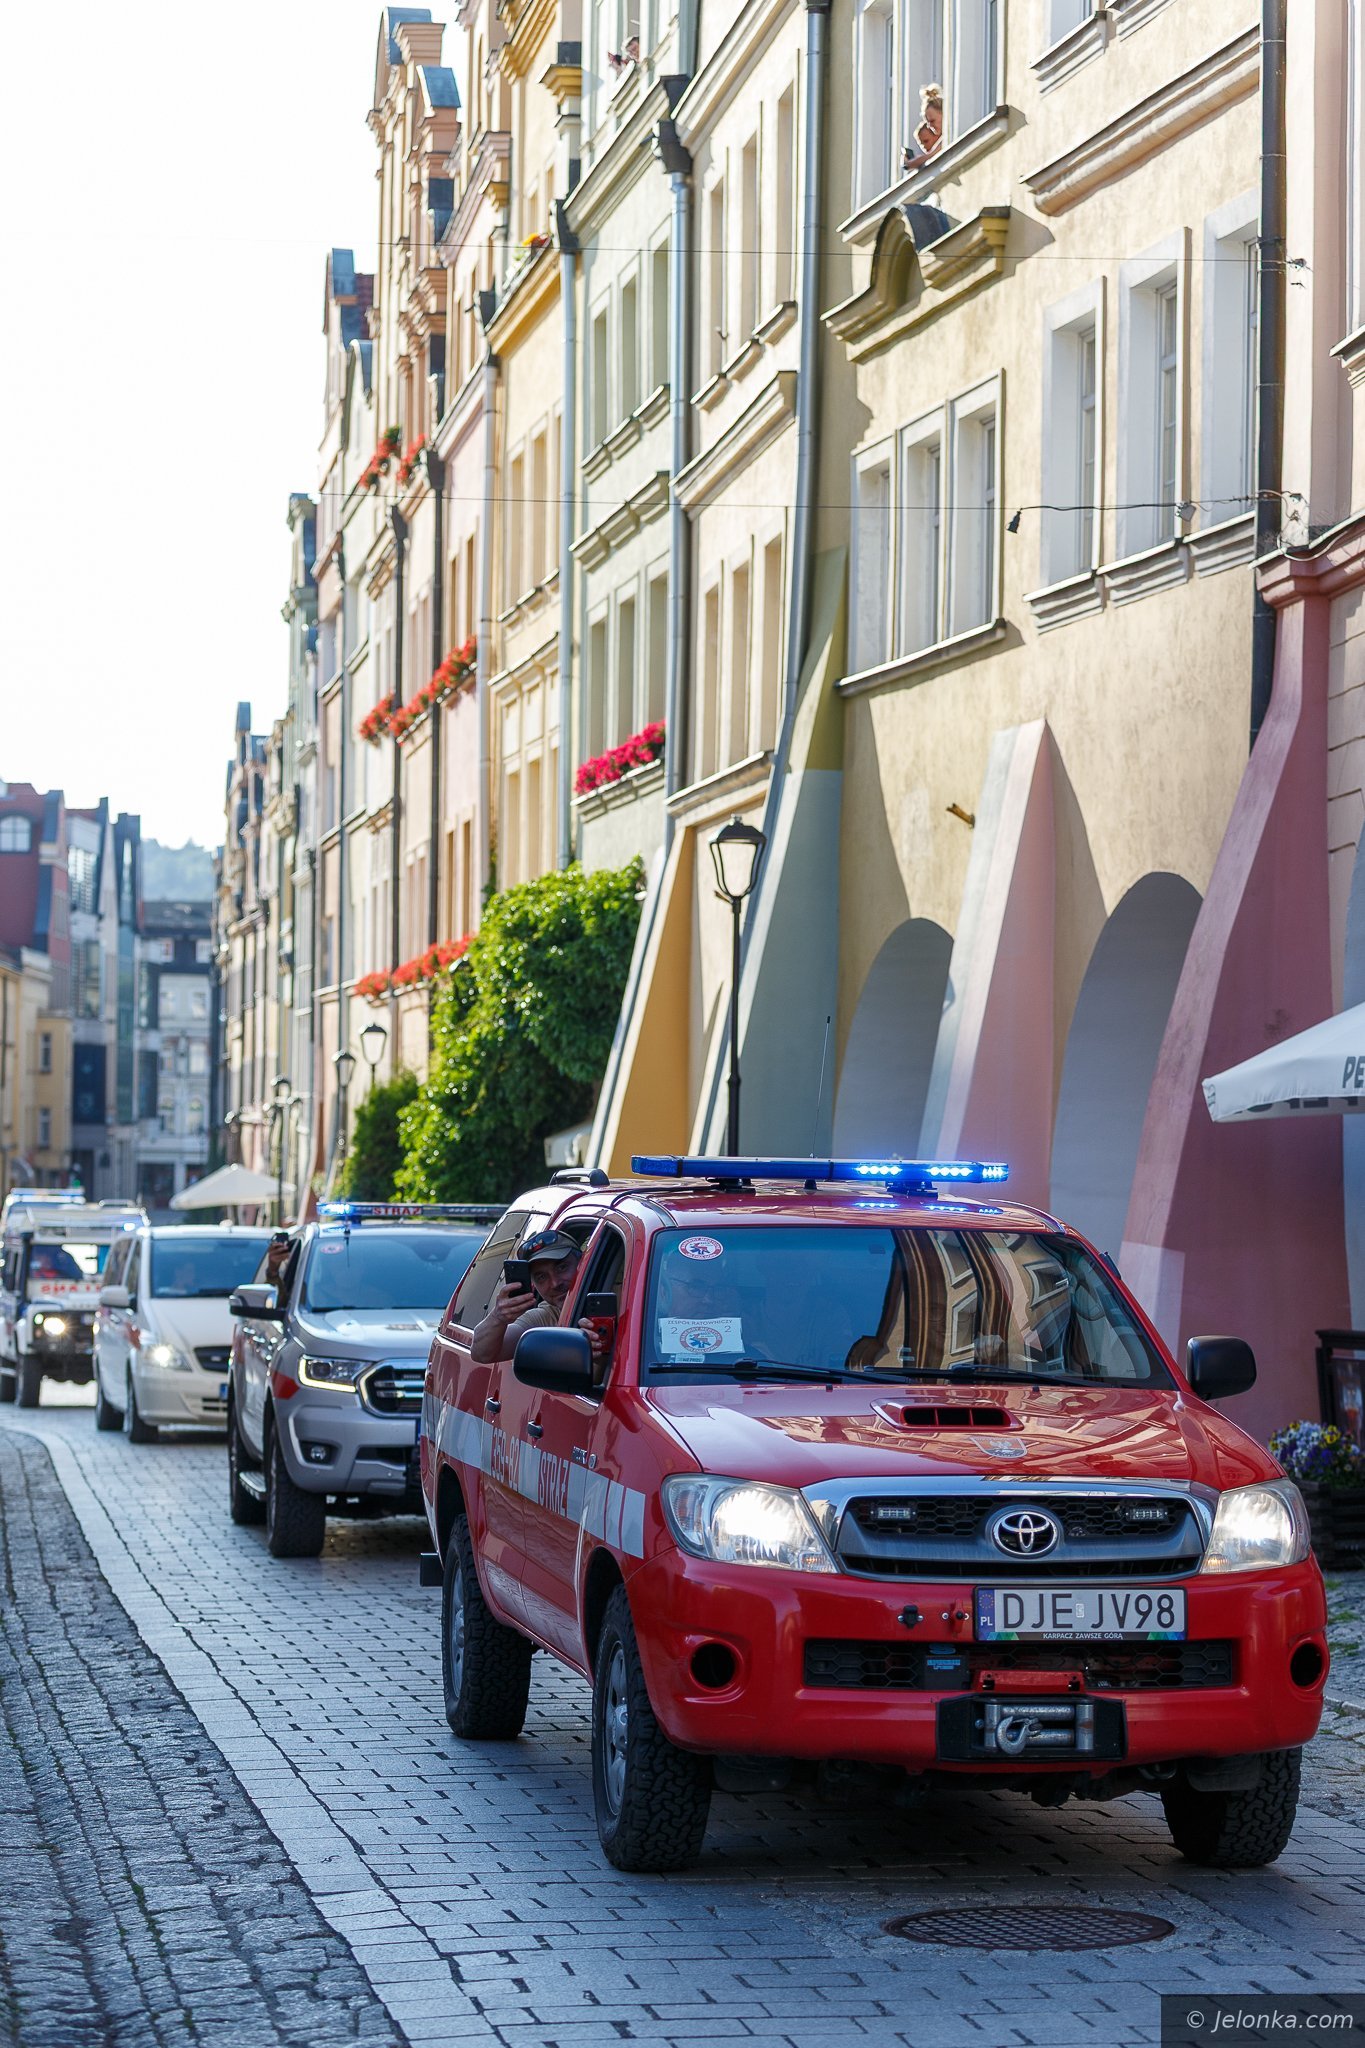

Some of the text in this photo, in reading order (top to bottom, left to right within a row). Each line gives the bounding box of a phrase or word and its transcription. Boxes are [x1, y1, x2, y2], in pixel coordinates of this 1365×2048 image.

[1003, 1593, 1175, 1629] DJE JV98
[980, 1616, 993, 1626] PL
[1043, 1632, 1073, 1640] KARPACZ
[1075, 1632, 1102, 1640] ZAWSZE
